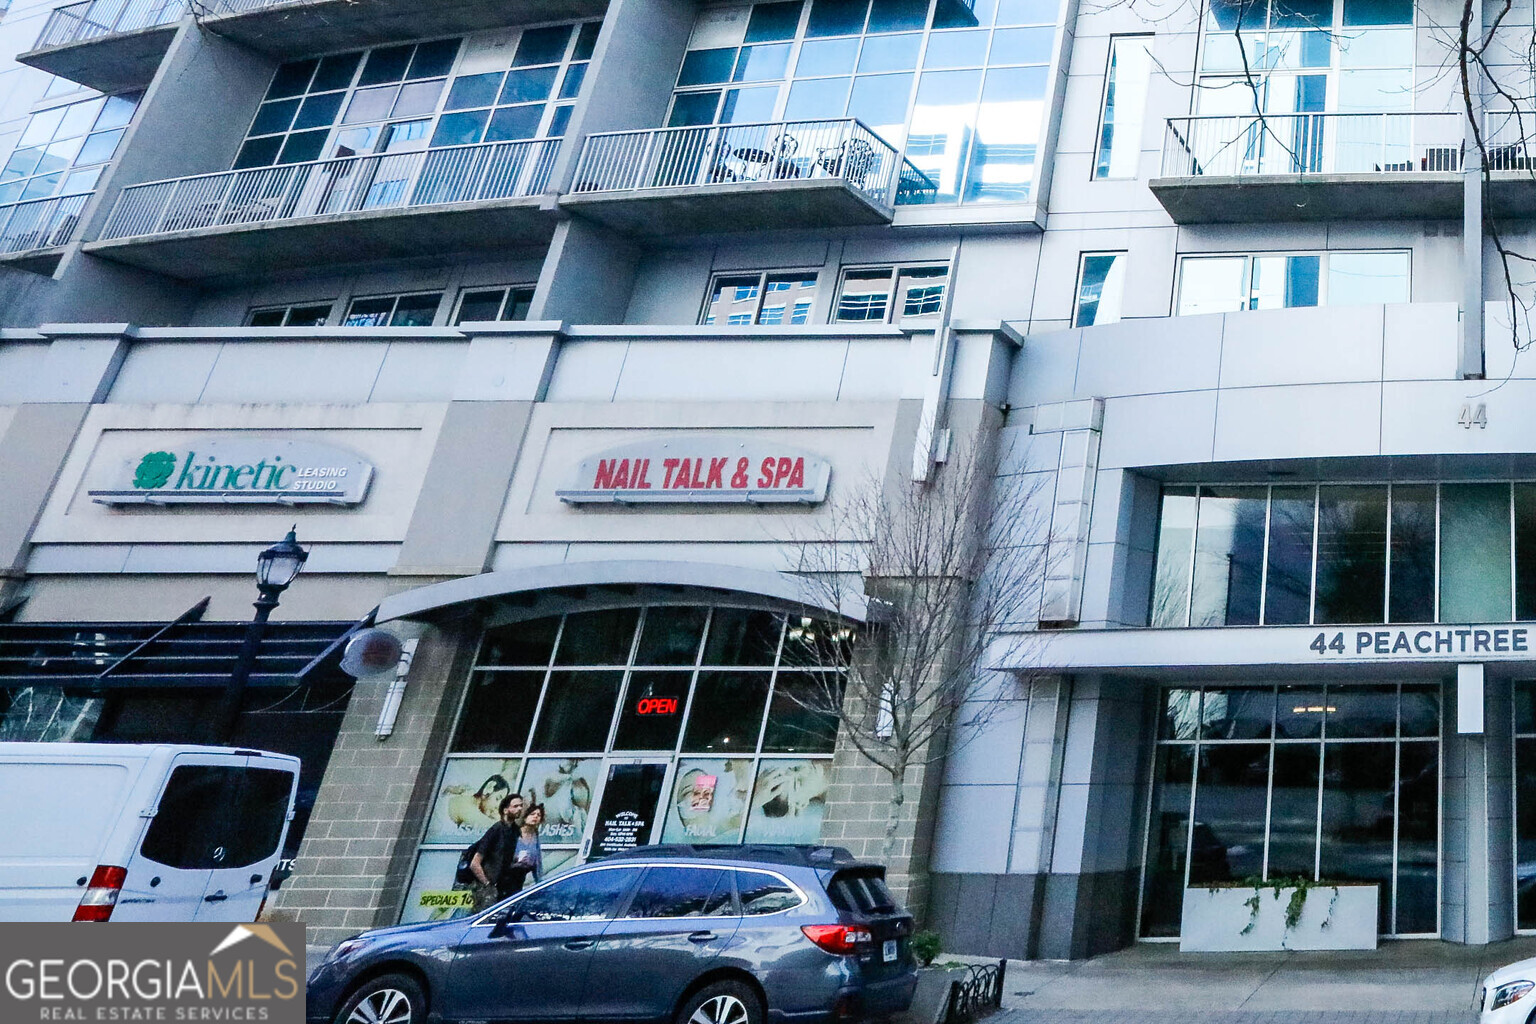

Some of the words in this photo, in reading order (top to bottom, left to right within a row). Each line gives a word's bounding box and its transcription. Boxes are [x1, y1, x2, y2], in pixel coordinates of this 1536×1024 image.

[1458, 403, 1488, 429] 44
[174, 451, 296, 490] kinetic
[297, 467, 347, 478] LEASING
[593, 458, 652, 489] NAIL
[662, 457, 729, 489] TALK
[730, 457, 750, 489] &
[757, 457, 805, 488] SPA
[293, 480, 337, 490] STUDIO
[1309, 631, 1346, 655] 44
[1356, 628, 1529, 654] PEACHTREE
[637, 697, 678, 714] OPEN
[420, 894, 459, 906] SPECIALS
